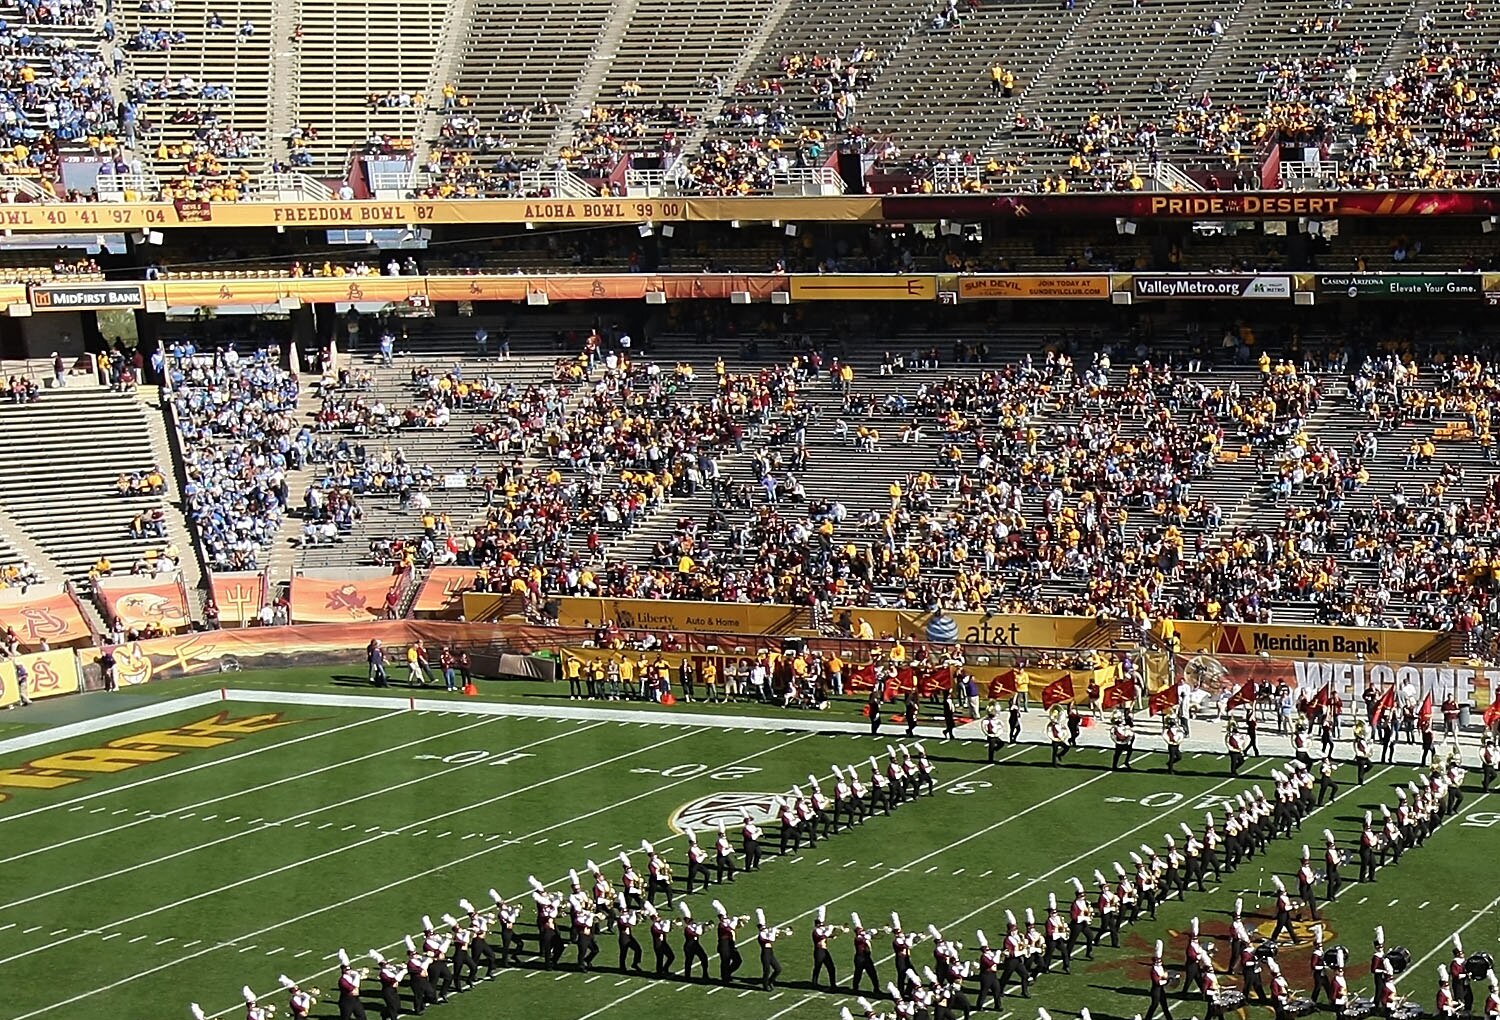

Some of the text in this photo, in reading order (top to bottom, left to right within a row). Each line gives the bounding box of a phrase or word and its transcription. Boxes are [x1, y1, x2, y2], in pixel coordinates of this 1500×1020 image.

[525, 203, 679, 218] ALOHA BOWL '99 '00
[1151, 196, 1223, 213] PRIDE
[1244, 196, 1339, 213] DESERT
[0, 210, 32, 225] OWL
[42, 210, 67, 224] '40
[75, 210, 98, 223] '41
[109, 210, 132, 223] '97
[141, 209, 166, 223] '04
[274, 206, 435, 221] FREEDOM BOWL '87
[965, 279, 1022, 291] SUN DEVIL
[1138, 280, 1240, 296] ValleyMetro.org
[1321, 277, 1384, 286] CASINO ARIZONA
[1390, 282, 1477, 293] Elevate Your Game.
[53, 292, 141, 306] MIDFIRST BANK
[638, 612, 740, 627] Liberty Auto & Home
[965, 622, 1021, 645] at&t
[1253, 631, 1380, 655] Meridian Bank
[1293, 661, 1477, 707] WELCOME
